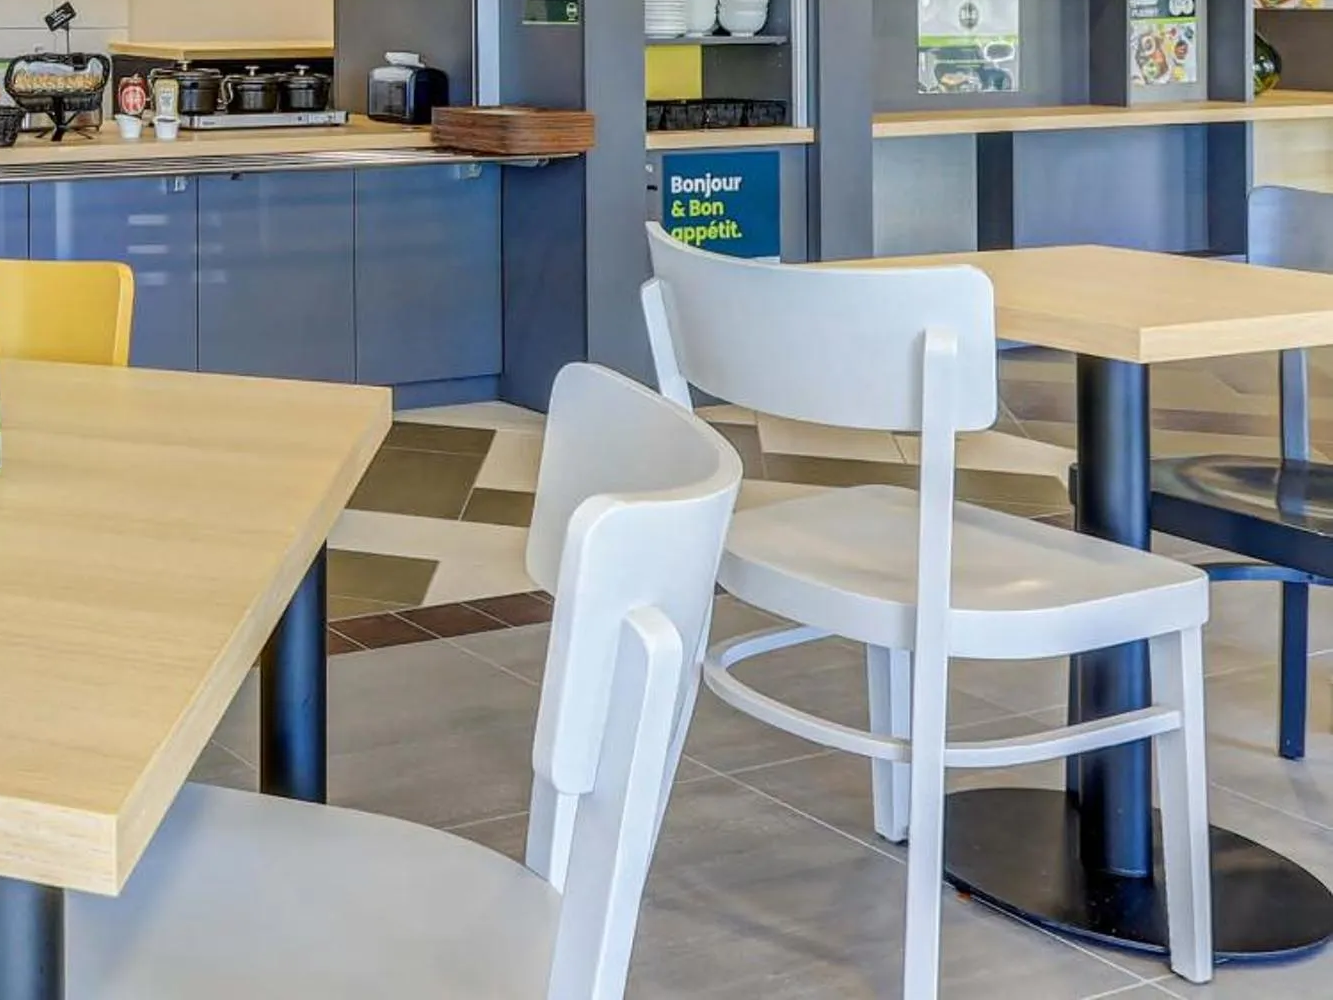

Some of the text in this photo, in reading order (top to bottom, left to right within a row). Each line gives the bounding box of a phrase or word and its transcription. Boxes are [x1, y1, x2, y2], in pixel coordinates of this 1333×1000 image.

[671, 172, 743, 198] Bonjour
[671, 199, 724, 217] & Bon
[671, 220, 743, 247] appétit.
